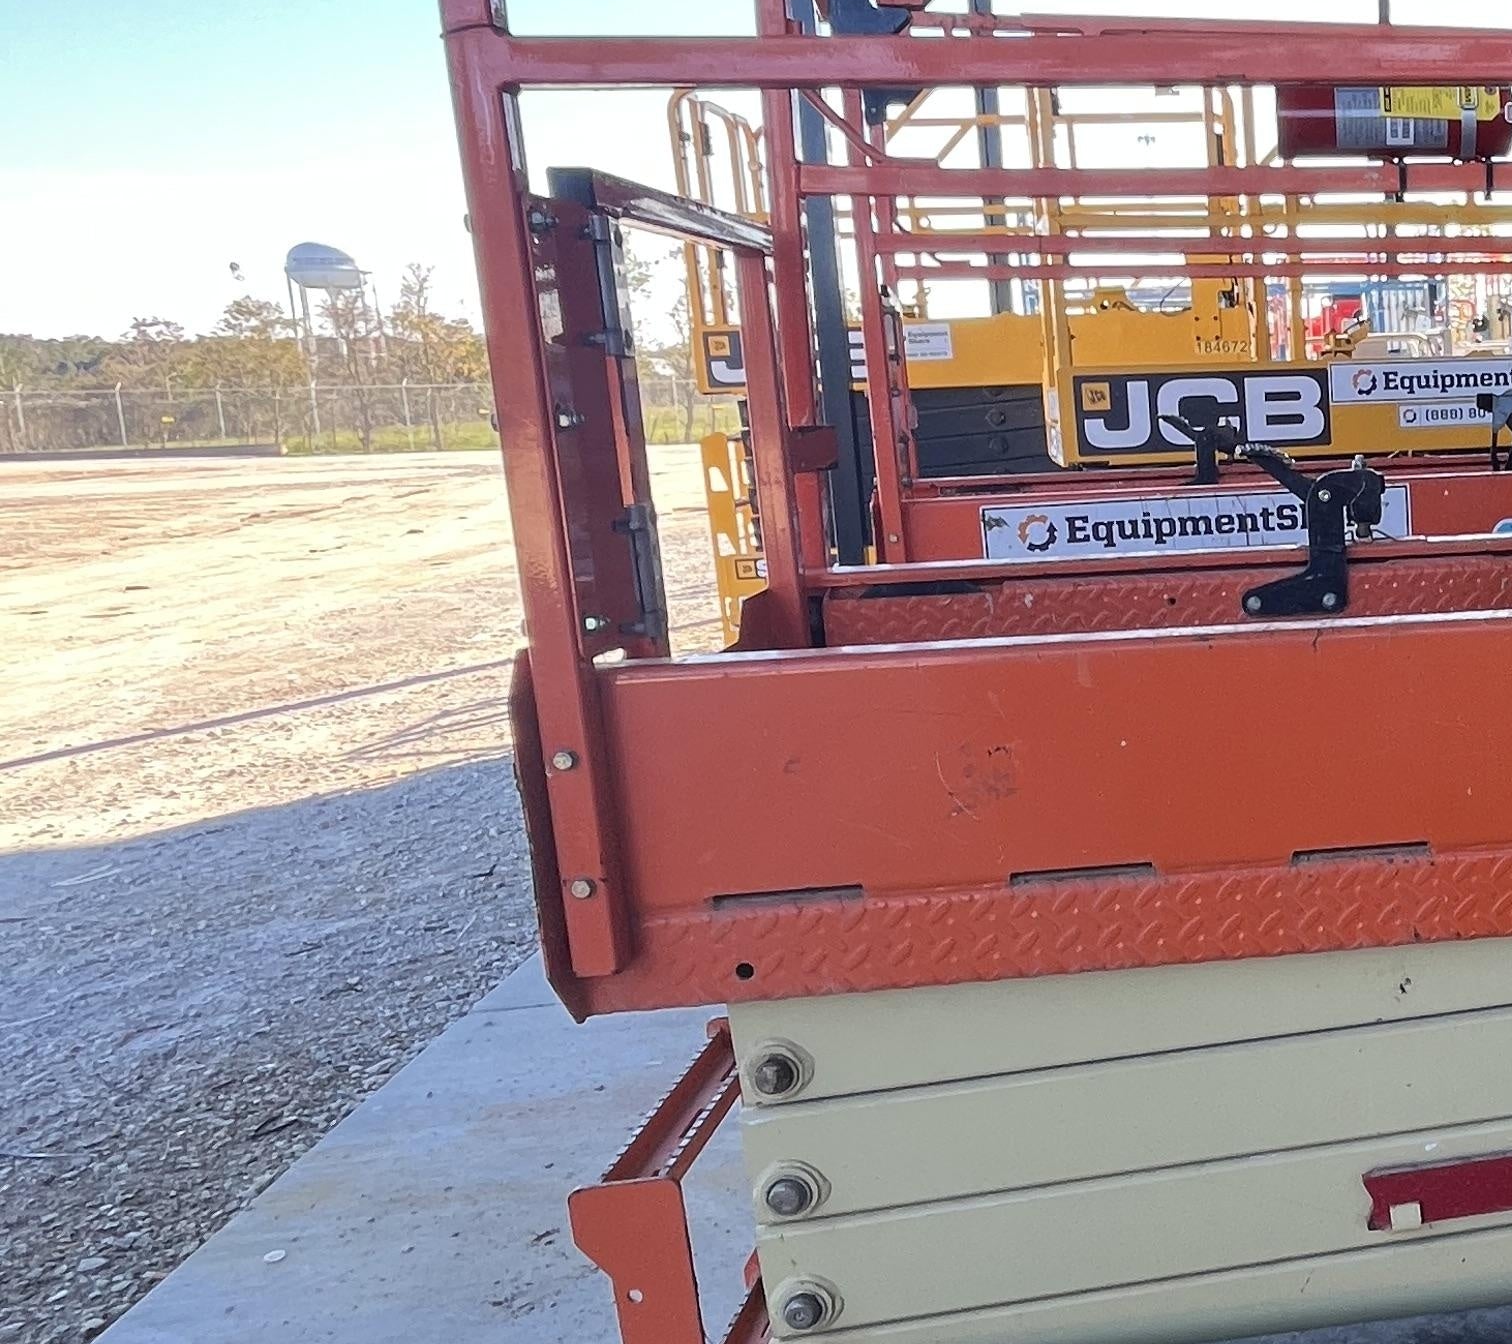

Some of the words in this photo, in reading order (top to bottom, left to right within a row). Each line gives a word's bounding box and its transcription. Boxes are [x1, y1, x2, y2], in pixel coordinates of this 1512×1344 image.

[1197, 340, 1248, 354] 184672
[1084, 375, 1325, 449] JCB
[1425, 408, 1463, 422] (888)
[1066, 503, 1308, 545] EquipmentS
